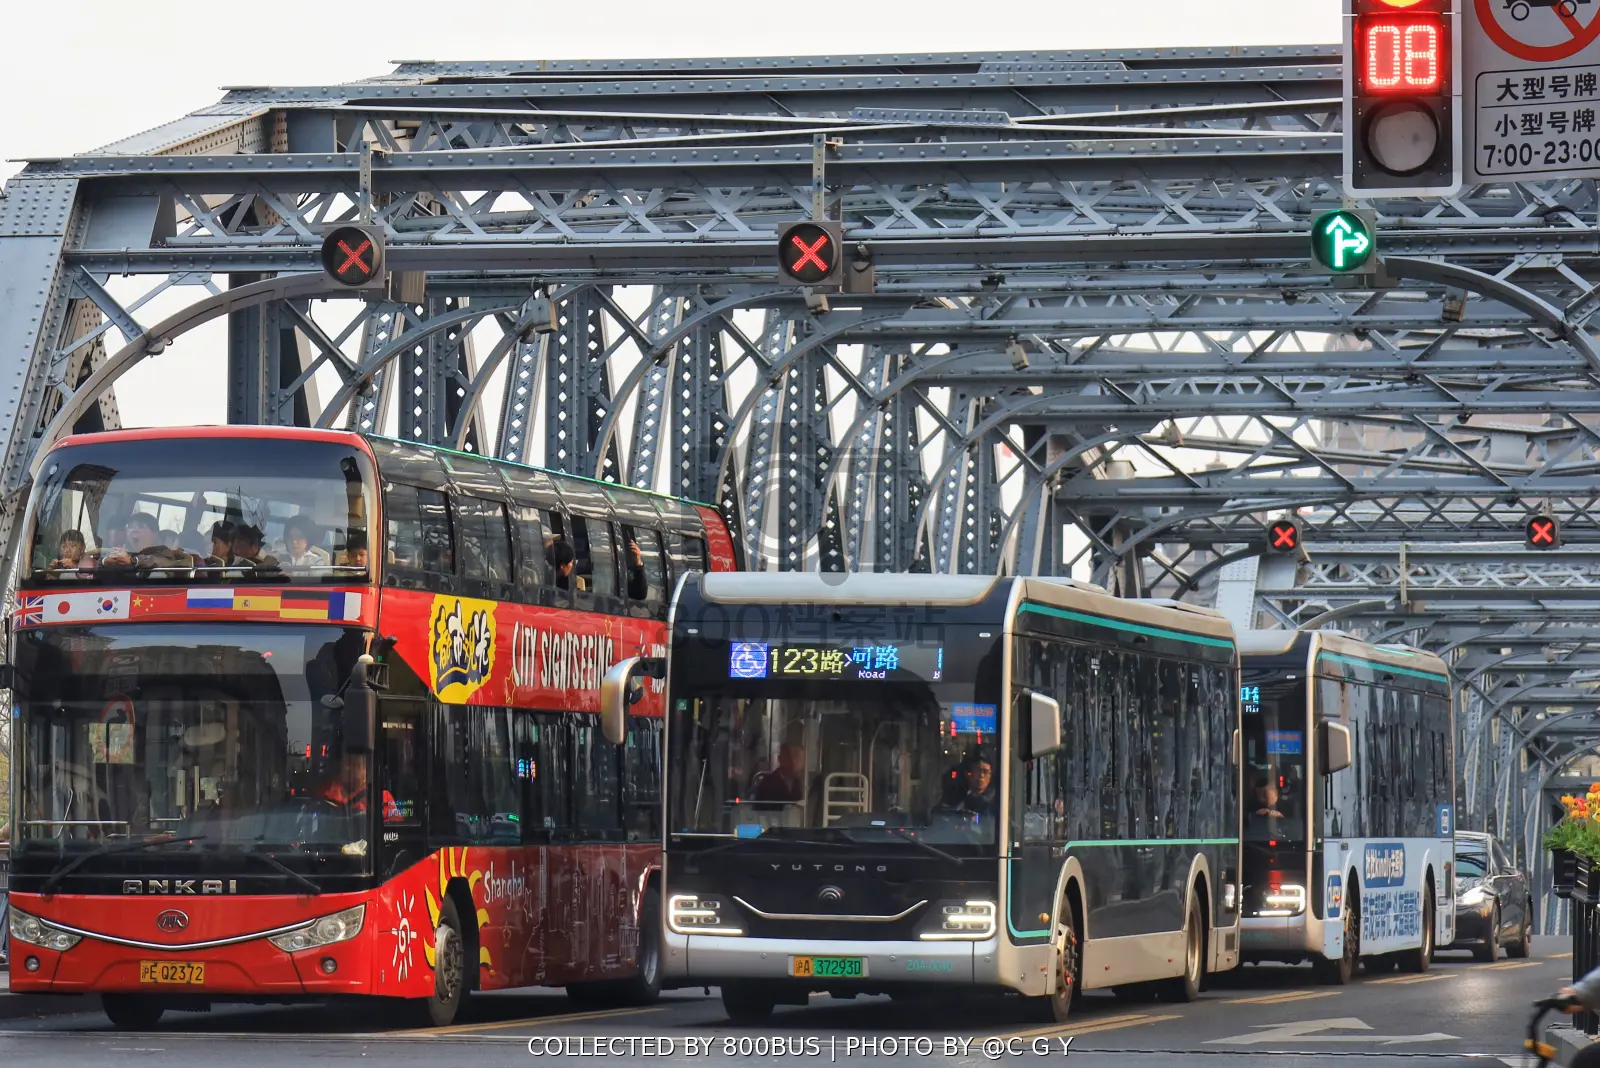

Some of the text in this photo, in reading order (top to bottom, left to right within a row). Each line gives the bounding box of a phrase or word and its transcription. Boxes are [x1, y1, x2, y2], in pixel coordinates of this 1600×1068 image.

[1369, 25, 1437, 85] 08
[1496, 72, 1598, 102] 大型号牌
[1494, 108, 1596, 138] 小型号牌
[512, 621, 614, 692] CITY SIGHTSEEING
[771, 648, 844, 673] 123路
[858, 670, 886, 679] Road
[771, 863, 887, 872] YUTONG
[123, 880, 237, 894] ANKAI
[484, 860, 525, 910] Shanghai
